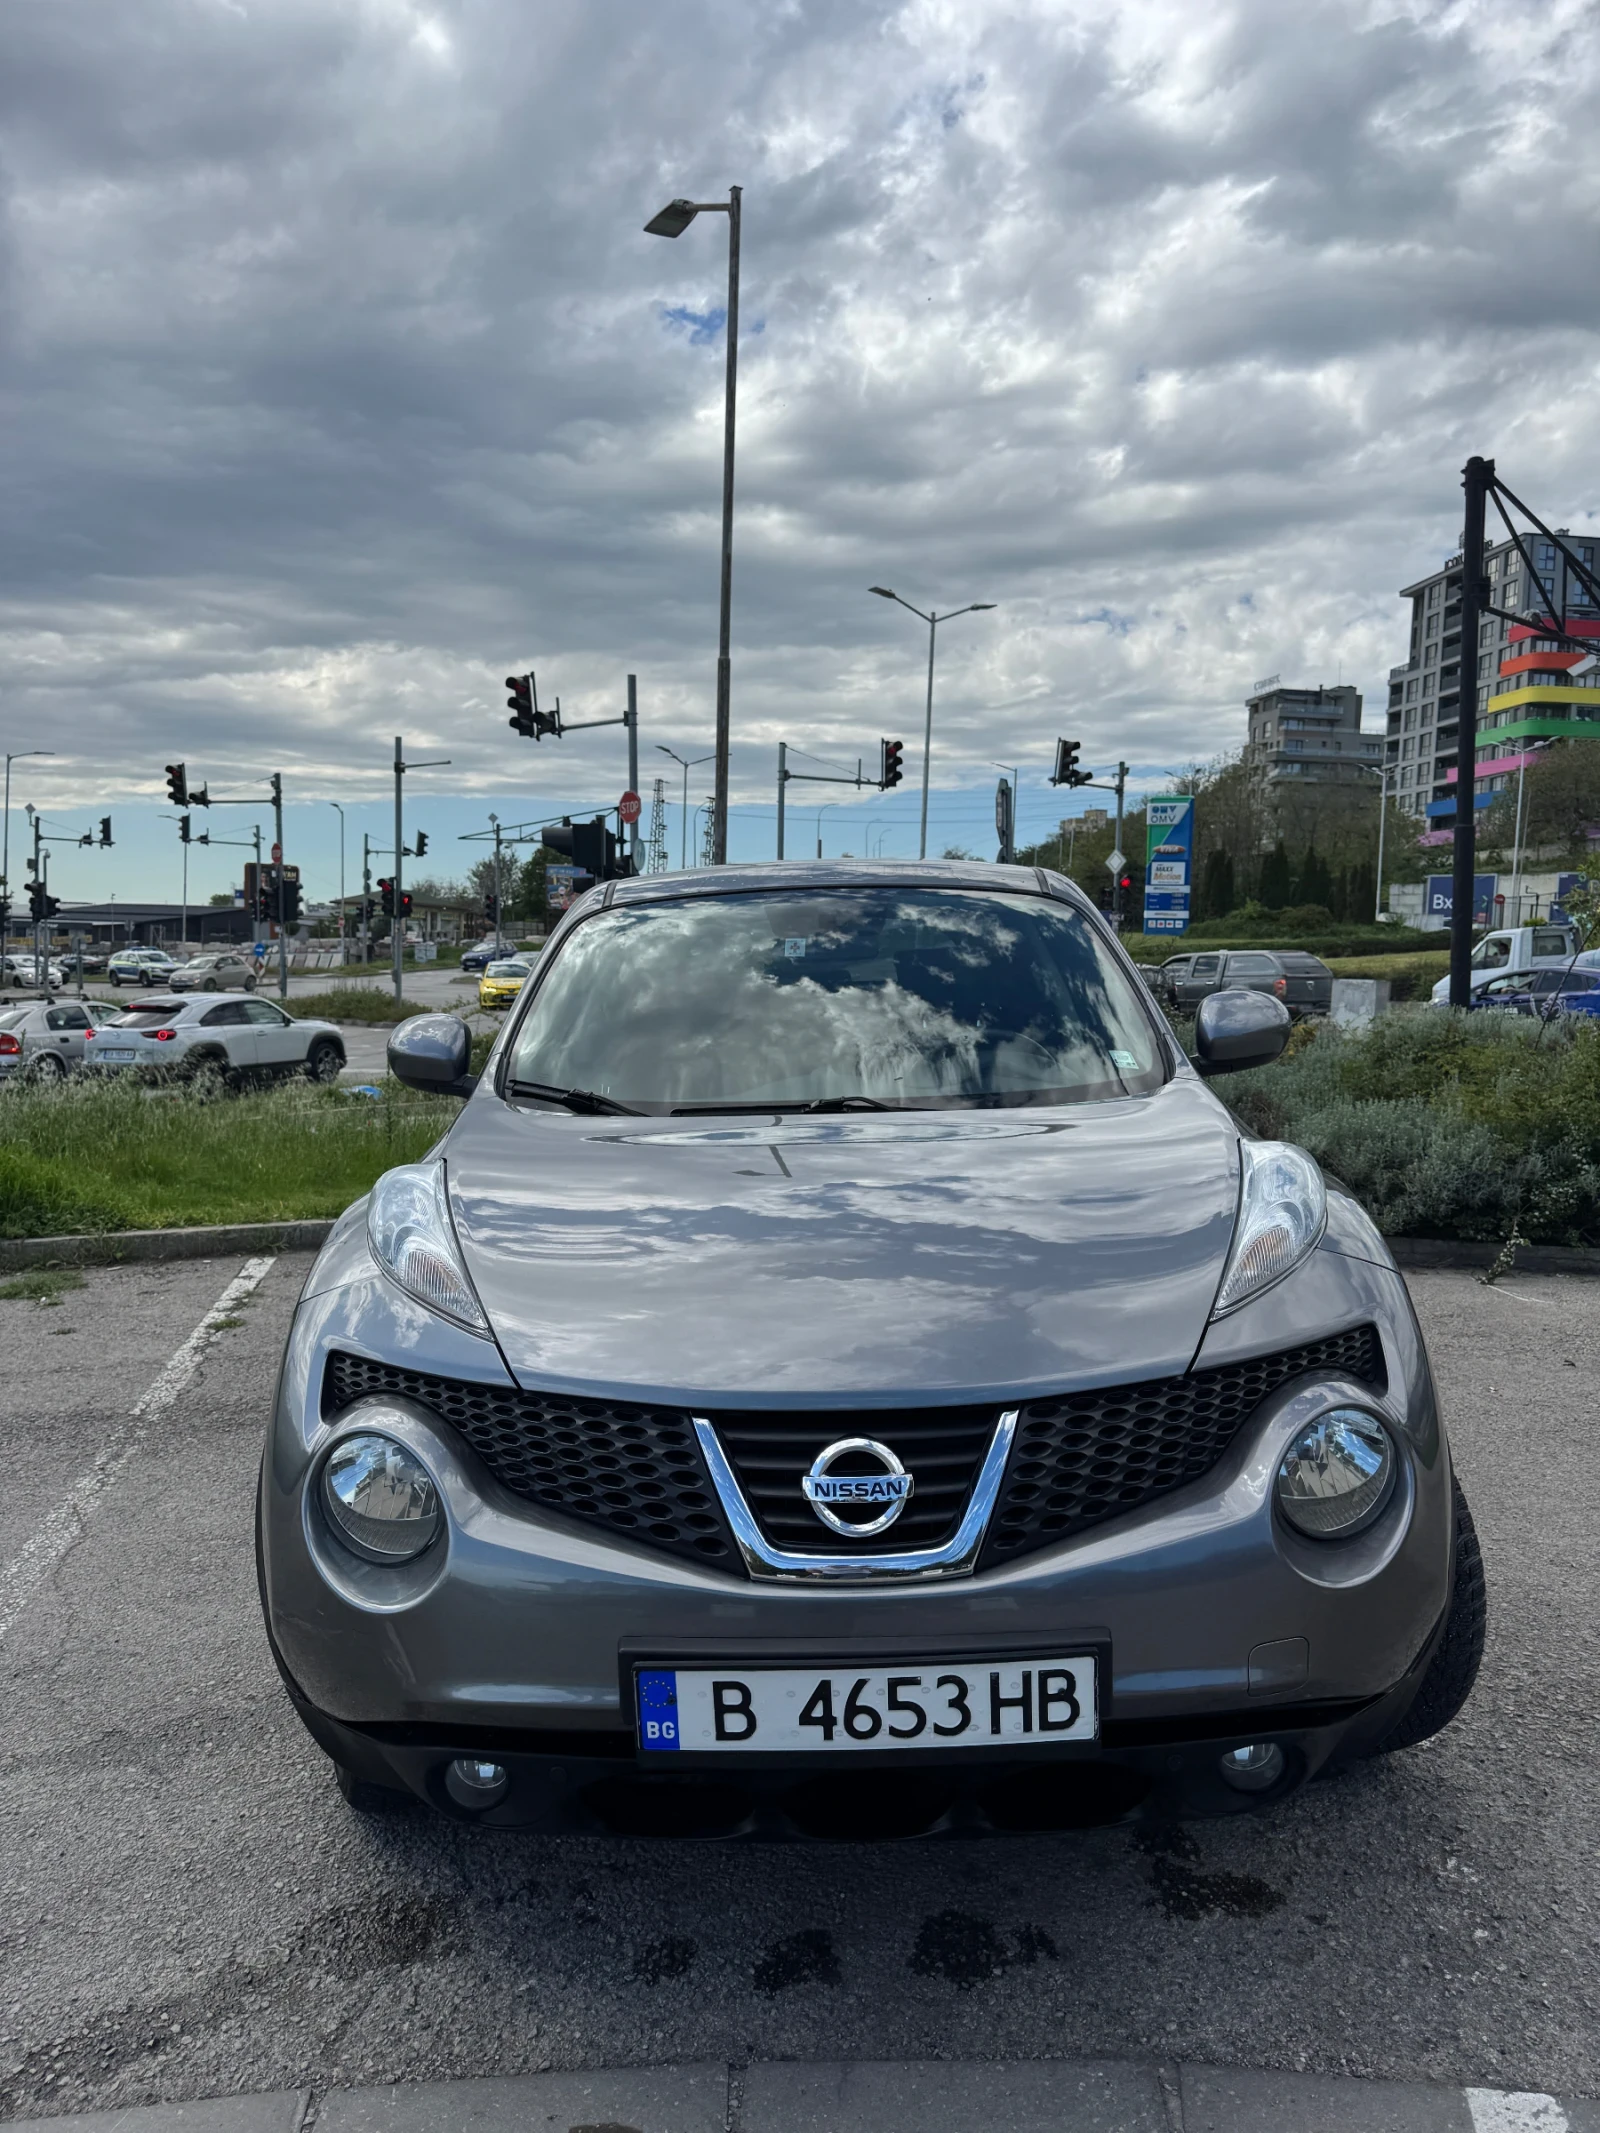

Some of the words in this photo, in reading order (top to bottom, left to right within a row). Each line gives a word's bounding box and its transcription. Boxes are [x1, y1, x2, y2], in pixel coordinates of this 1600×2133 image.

[621, 801, 639, 814] STOP
[1150, 815, 1176, 823] OMV
[814, 1480, 903, 1498] NISSAN
[712, 1680, 757, 1742] B
[798, 1674, 972, 1741] 4653
[989, 1668, 1081, 1735] HB
[646, 1720, 676, 1739] BG
